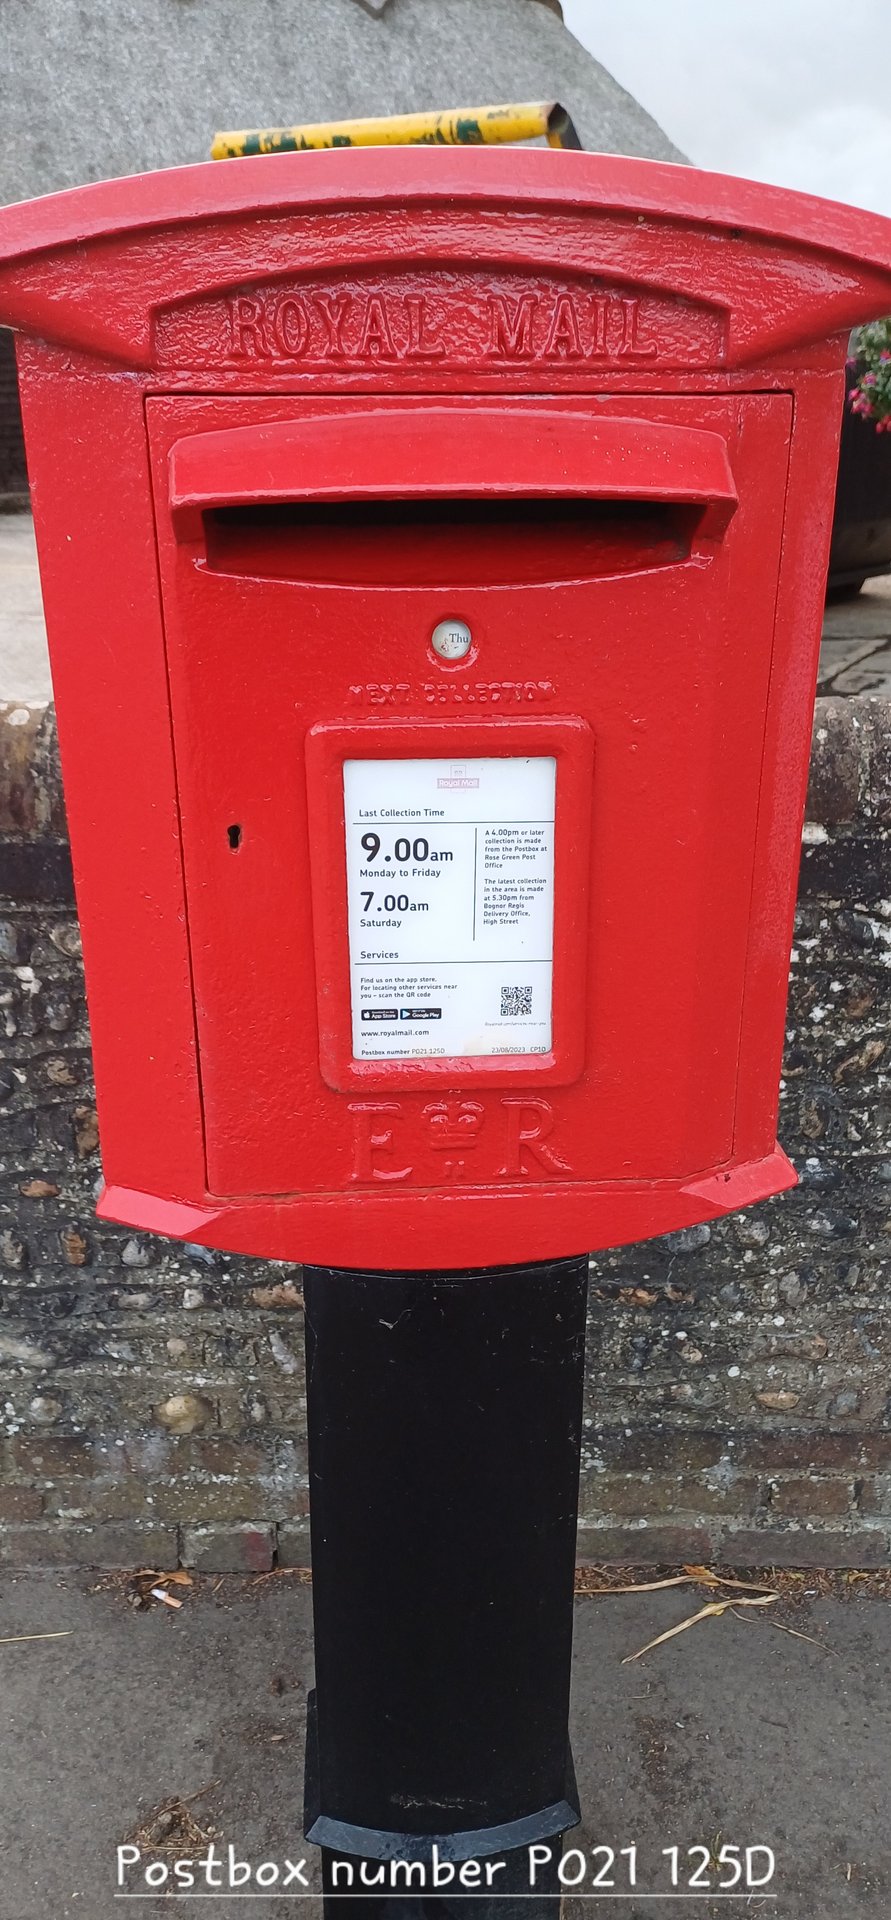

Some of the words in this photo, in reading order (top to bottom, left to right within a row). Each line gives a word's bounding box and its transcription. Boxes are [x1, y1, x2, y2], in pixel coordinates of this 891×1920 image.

[230, 293, 445, 357] ROYAL
[487, 293, 657, 358] MAIL
[449, 633, 469, 643] Thu
[350, 683, 410, 704] NEXT
[424, 681, 555, 703] COLLECTION
[439, 779, 460, 789] Royal
[461, 779, 478, 787] Mail
[359, 809, 377, 817] Last
[380, 809, 421, 817] Collection
[424, 808, 445, 817] Time
[361, 832, 454, 862] 9.00am
[360, 869, 396, 879] Monday
[400, 869, 409, 877] to
[412, 868, 441, 878] Friday
[360, 891, 429, 912] 7.00am
[360, 919, 402, 928] Saturday
[360, 951, 399, 959] Services
[361, 1030, 429, 1038] www.royalmail.com
[348, 1102, 413, 1184] E
[493, 1097, 573, 1177] R
